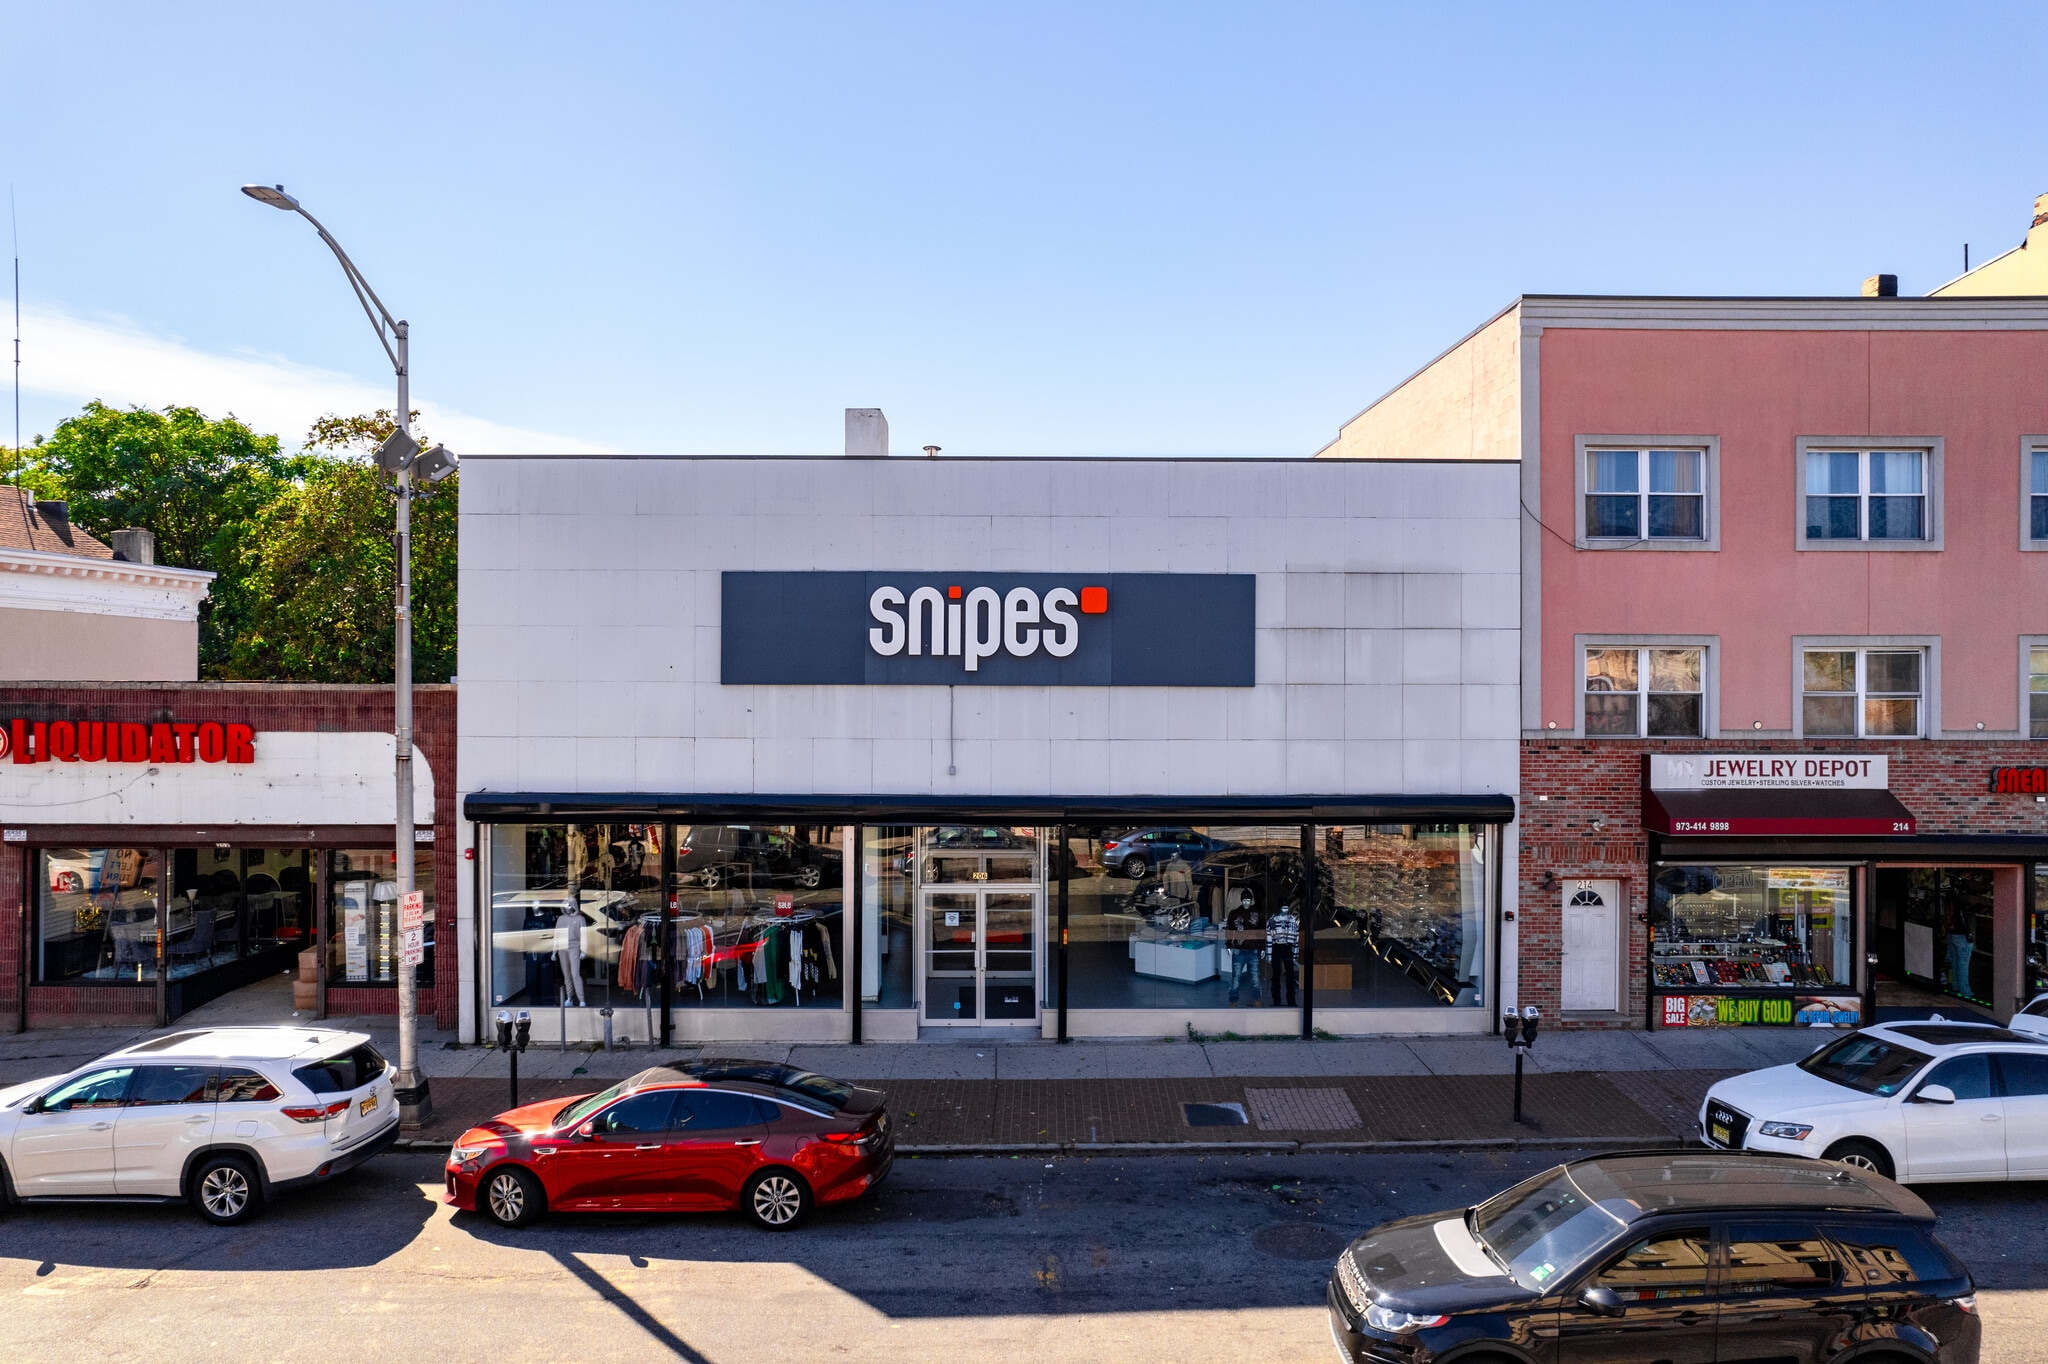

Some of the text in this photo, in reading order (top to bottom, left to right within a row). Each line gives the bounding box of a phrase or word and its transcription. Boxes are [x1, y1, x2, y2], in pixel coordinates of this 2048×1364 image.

[869, 585, 1079, 672] snipes
[11, 718, 256, 764] LIQUIDATOR
[1704, 760, 1797, 778] JEWELRY
[1804, 760, 1872, 778] DEPOT
[1701, 779, 1727, 788] CUSTOM
[1790, 779, 1812, 788] SILVER
[1995, 767, 2048, 793] SNEA
[1675, 822, 1729, 831] 973-414 9898
[1893, 822, 1909, 831] 214
[1577, 880, 1593, 890] 214
[408, 894, 417, 903] NO
[404, 902, 422, 911] PARKING
[777, 901, 791, 909] sale
[411, 931, 417, 942] 2
[408, 940, 420, 950] HOUR
[404, 947, 423, 956] PARKING
[408, 954, 419, 963] LIMIT
[1665, 997, 1685, 1012] BIG
[1717, 999, 1792, 1022] WE BUY GOLD
[1665, 1013, 1685, 1024] SALE
[1797, 1010, 1808, 1023] WE
[1831, 1010, 1859, 1023] JEWELRY
